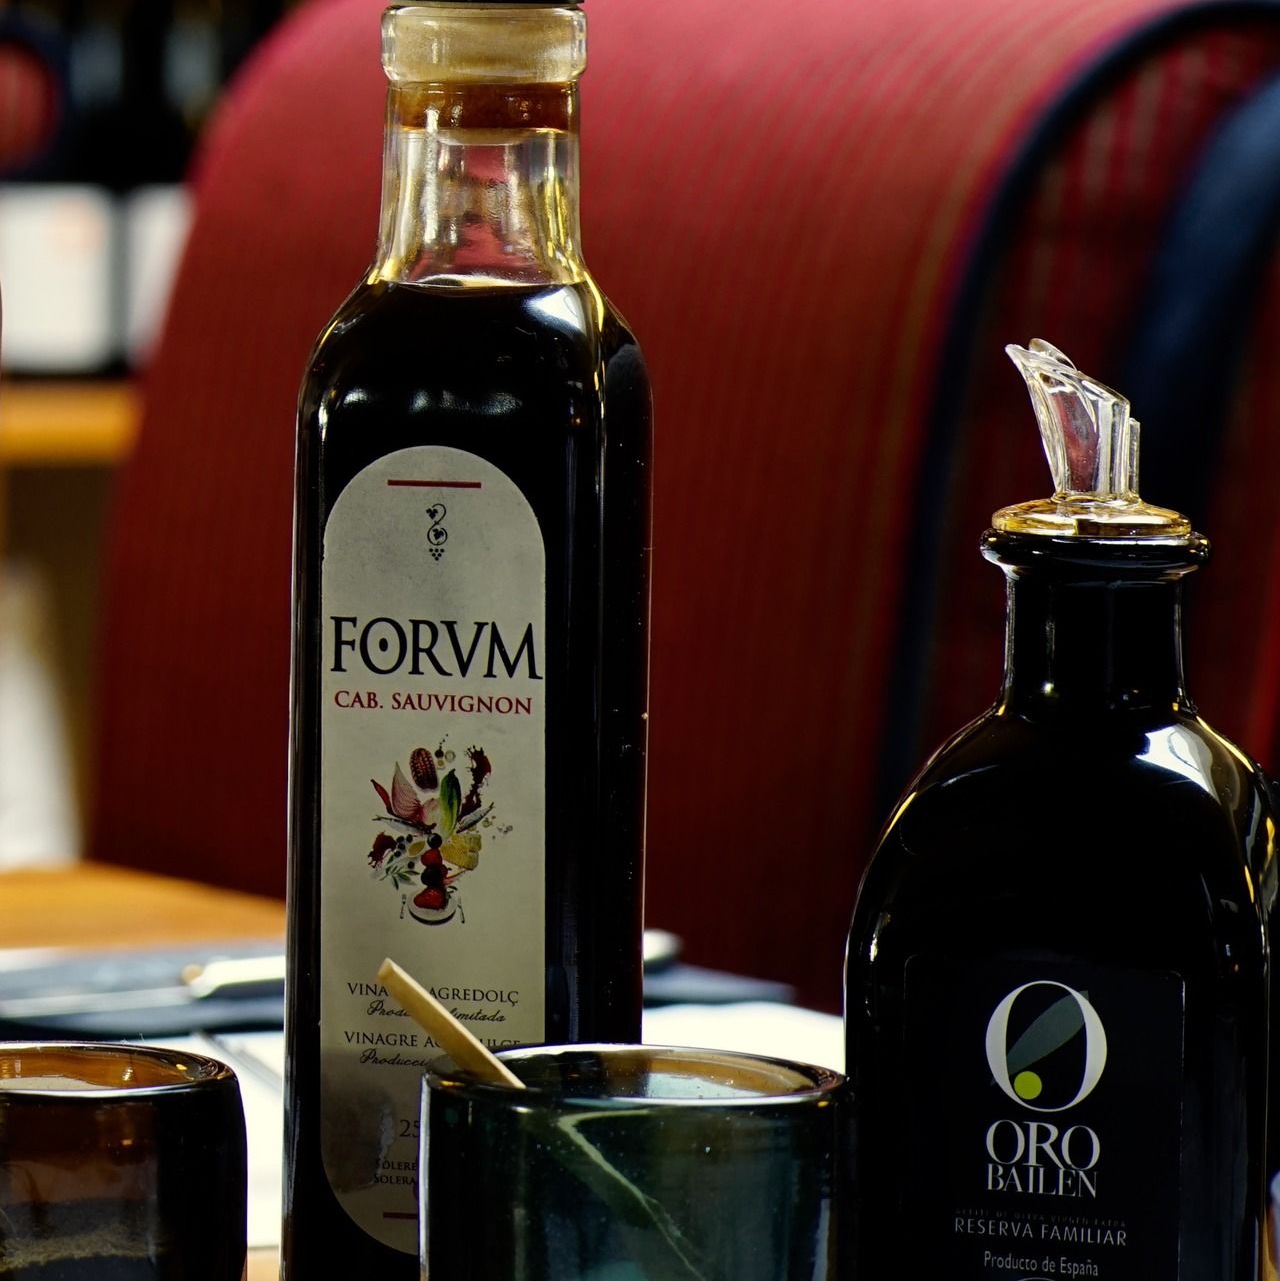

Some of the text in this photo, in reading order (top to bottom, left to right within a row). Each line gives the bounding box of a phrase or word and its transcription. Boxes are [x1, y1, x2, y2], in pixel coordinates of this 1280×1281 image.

[329, 615, 544, 681] FORVM
[333, 689, 533, 716] CAB. SAUVIGNON
[347, 982, 520, 1008] VINA AGREDOLÇ
[344, 1031, 418, 1048] VINAGRE
[985, 1119, 1101, 1171] ORO
[954, 1217, 1128, 1247] RESERVA FAMILIAR
[984, 1250, 1100, 1280] Producto de España
